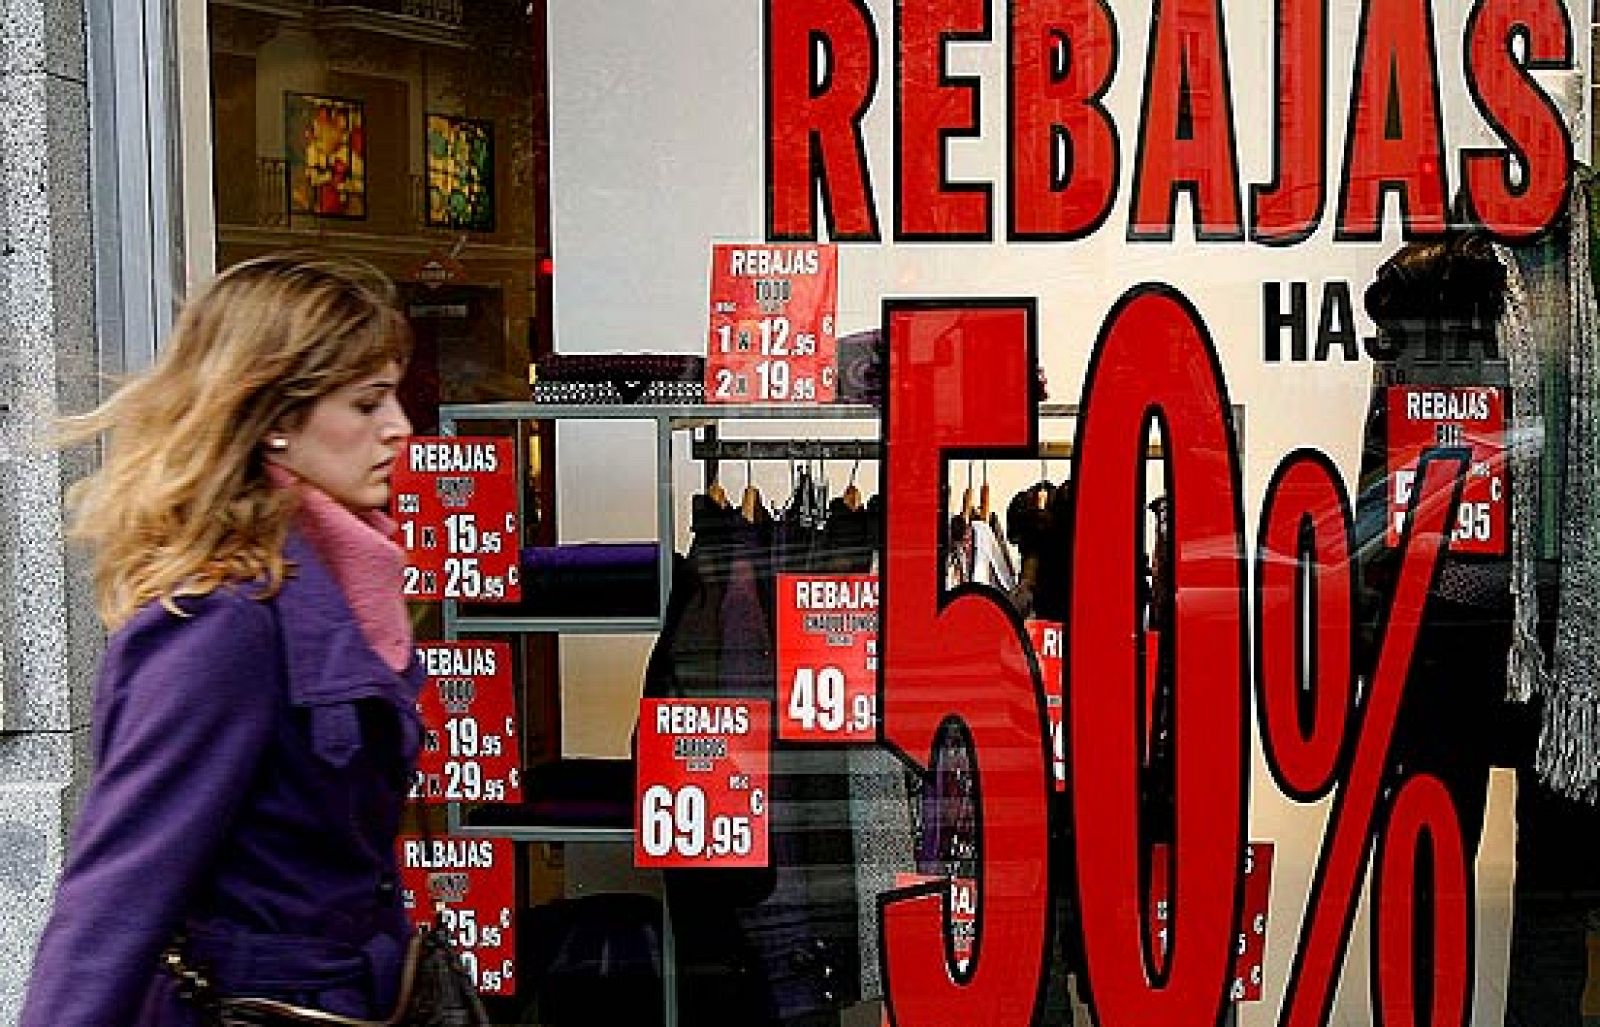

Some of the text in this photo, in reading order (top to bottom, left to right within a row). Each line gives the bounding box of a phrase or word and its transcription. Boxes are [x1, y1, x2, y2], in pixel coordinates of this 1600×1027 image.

[763, 0, 1575, 242] REBAJAS
[732, 250, 819, 275] REBAJAS
[716, 369, 731, 397] 2
[1407, 392, 1490, 420] REBAJAS
[410, 444, 498, 471] REBAJAS
[401, 520, 414, 550] 1
[403, 566, 419, 594] 2
[880, 282, 1476, 1027] 50%
[657, 704, 749, 734] REBAJAS
[642, 785, 751, 859] 69,95
